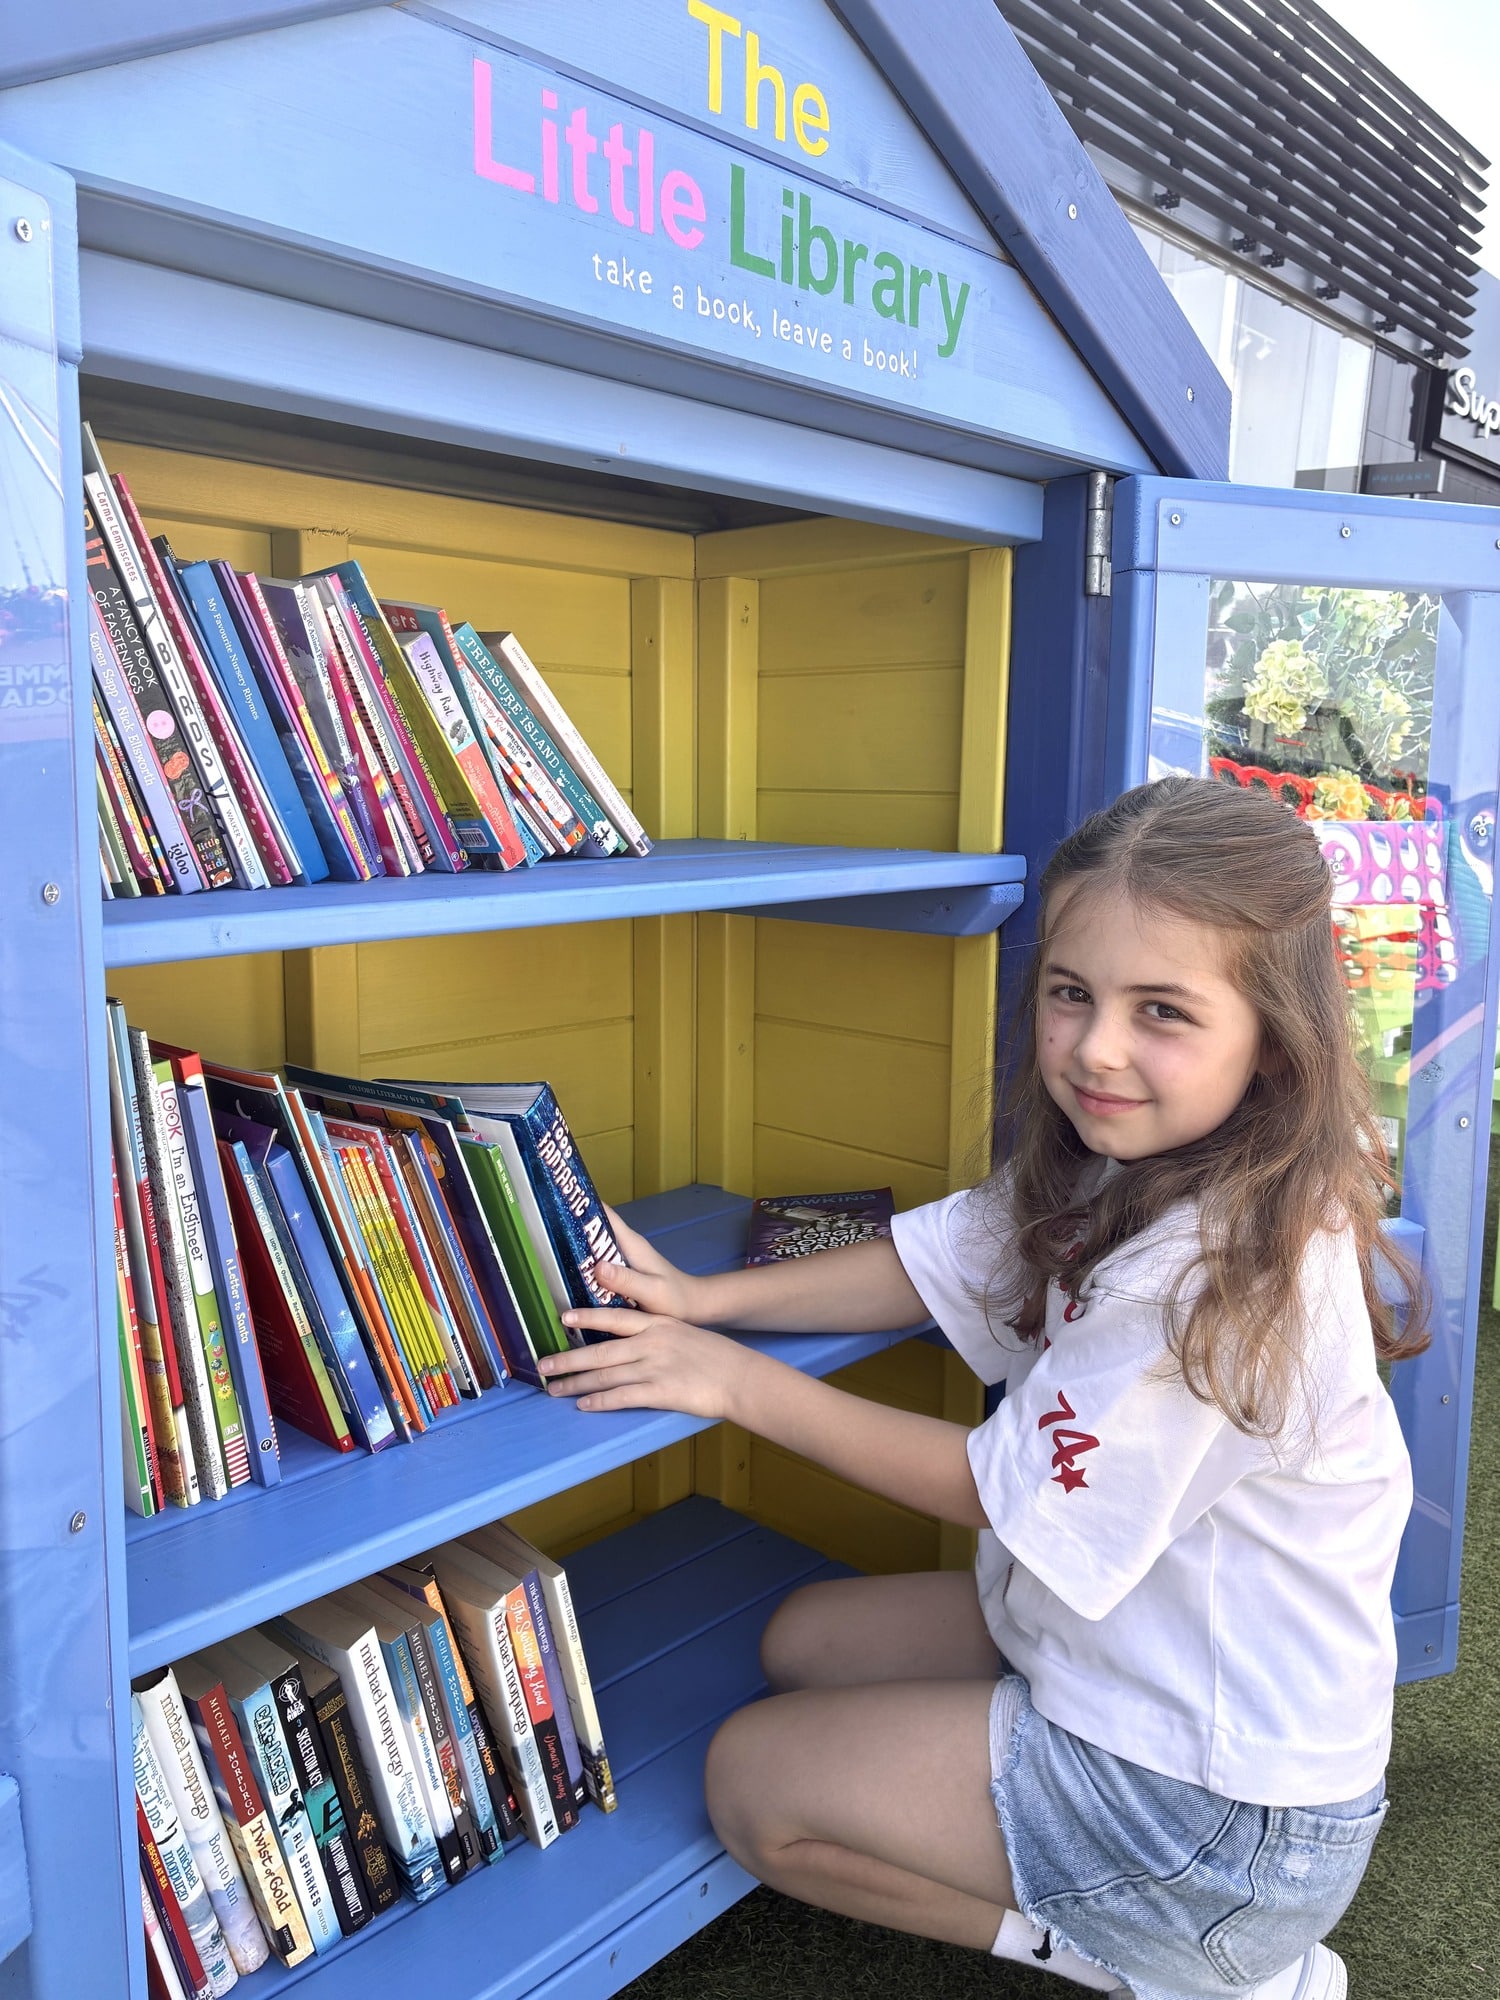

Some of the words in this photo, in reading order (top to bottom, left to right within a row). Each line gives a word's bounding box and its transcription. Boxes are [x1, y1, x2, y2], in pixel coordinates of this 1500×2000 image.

[687, 0, 830, 157] The
[473, 57, 706, 250] Little
[730, 163, 970, 358] Library
[592, 253, 653, 295] take
[672, 284, 684, 310] a
[698, 285, 763, 338] book,
[772, 308, 832, 354] leave
[842, 337, 852, 359] a
[863, 346, 918, 379] book!
[96, 492, 114, 523] Carme
[110, 525, 138, 582] Lemniscates
[298, 596, 313, 627] Magic
[95, 590, 109, 609] OF
[104, 614, 144, 694] FASTENINGS
[109, 587, 120, 597] A
[115, 599, 143, 644] FANCY
[135, 647, 158, 688] BOOK
[207, 597, 217, 613] My
[214, 614, 233, 653] Favourite
[230, 653, 247, 687] Nursery
[243, 687, 259, 720] Rhymes
[156, 642, 213, 767] BIRDS
[420, 651, 443, 694] Highway
[440, 696, 455, 717] Rat
[465, 637, 522, 716] TREASURE
[519, 715, 560, 769] ISLAND
[89, 631, 107, 666] Karen
[103, 669, 119, 697] Sapp
[117, 706, 134, 732] Nick
[128, 734, 155, 786] Ellsworth
[382, 693, 394, 712] Frozen
[391, 712, 408, 745] Adventure
[478, 692, 496, 720] Wimpy
[494, 717, 506, 733] Kid
[167, 843, 190, 875] igloo
[226, 809, 242, 838] WALKER
[240, 847, 256, 875] STUDIO
[161, 1088, 183, 1140] LOOK
[554, 1107, 570, 1133] OVER
[134, 1119, 145, 1154] FACTS
[552, 1120, 573, 1159] 1000
[139, 1158, 147, 1175] ON
[171, 1146, 184, 1169] I'm
[175, 1173, 186, 1189] an
[773, 1193, 877, 1207] HAWKING
[144, 1181, 158, 1247] DINOSAURS
[244, 1174, 263, 1209] Animal
[257, 1207, 273, 1236] World
[181, 1191, 204, 1262] Engineer
[778, 1232, 875, 1249] COSMIC
[225, 1258, 231, 1266] A
[269, 1238, 278, 1252] LION
[274, 1252, 283, 1268] CUBS
[227, 1266, 240, 1300] Letter
[234, 1301, 241, 1312] to
[236, 1313, 250, 1344] Santa
[510, 1599, 523, 1622] The
[560, 1579, 572, 1611] michael
[529, 1582, 543, 1619] michael
[537, 1616, 551, 1655] morpurgo
[565, 1610, 578, 1643] morpurgo
[412, 1632, 430, 1680] MICHAEL
[435, 1626, 452, 1674] MICHAEL
[515, 1620, 538, 1679] Switching
[494, 1612, 514, 1669] michael
[506, 1667, 528, 1735] morpurgo
[529, 1679, 547, 1706] Hour
[286, 1698, 303, 1717] ALEX
[287, 1705, 306, 1722] RIDER
[333, 1716, 343, 1733] THE
[360, 1643, 388, 1706] michael
[377, 1703, 404, 1776] morpurgo
[160, 1692, 191, 1755] michael
[179, 1751, 210, 1820] morpurgo
[209, 1696, 231, 1751] MICHAEL
[227, 1752, 256, 1817] MORPURGO
[295, 1727, 322, 1774] SKELETON
[418, 1732, 430, 1758] private
[426, 1757, 440, 1791] peaceful
[464, 1735, 474, 1760] Why
[468, 1707, 478, 1735] Long
[475, 1729, 486, 1751] Way
[481, 1746, 496, 1776] Home
[142, 1738, 159, 1779] Amazing
[155, 1774, 167, 1800] Story
[163, 1799, 173, 1810] of
[307, 1767, 324, 1789] KEY
[401, 1771, 415, 1797] Alone
[411, 1795, 417, 1807] on
[438, 1740, 454, 1771] War
[446, 1766, 462, 1809] Horse
[471, 1764, 484, 1796] Whales
[525, 1743, 538, 1776] MEDAL
[535, 1782, 549, 1815] LEROY
[143, 1788, 164, 1829] Tips
[396, 1787, 408, 1815] Wide
[404, 1810, 414, 1829] Sea
[477, 1796, 488, 1818] Came
[146, 1841, 159, 1869] RESCUE
[177, 1843, 199, 1890] michael
[208, 1832, 225, 1868] Born
[249, 1818, 273, 1868] Twist
[264, 1868, 276, 1880] of
[270, 1876, 291, 1915] Gold
[365, 1844, 384, 1885] DELANEY
[375, 1845, 388, 1877] JOSEPH
[155, 1867, 163, 1878] AT
[158, 1876, 169, 1891] SEA
[162, 1850, 189, 1902] morpurgo
[219, 1865, 230, 1880] to
[223, 1876, 239, 1906] Run
[293, 1831, 302, 1855] ALI
[299, 1854, 322, 1907] SPARKES
[316, 1908, 329, 1937] OXFORD
[328, 1835, 350, 1875] ANTHONY
[339, 1872, 363, 1918] HOROWITZ
[378, 1888, 391, 1899] RED
[380, 1893, 393, 1905] FOX
[282, 1926, 294, 1951] EGMONT
